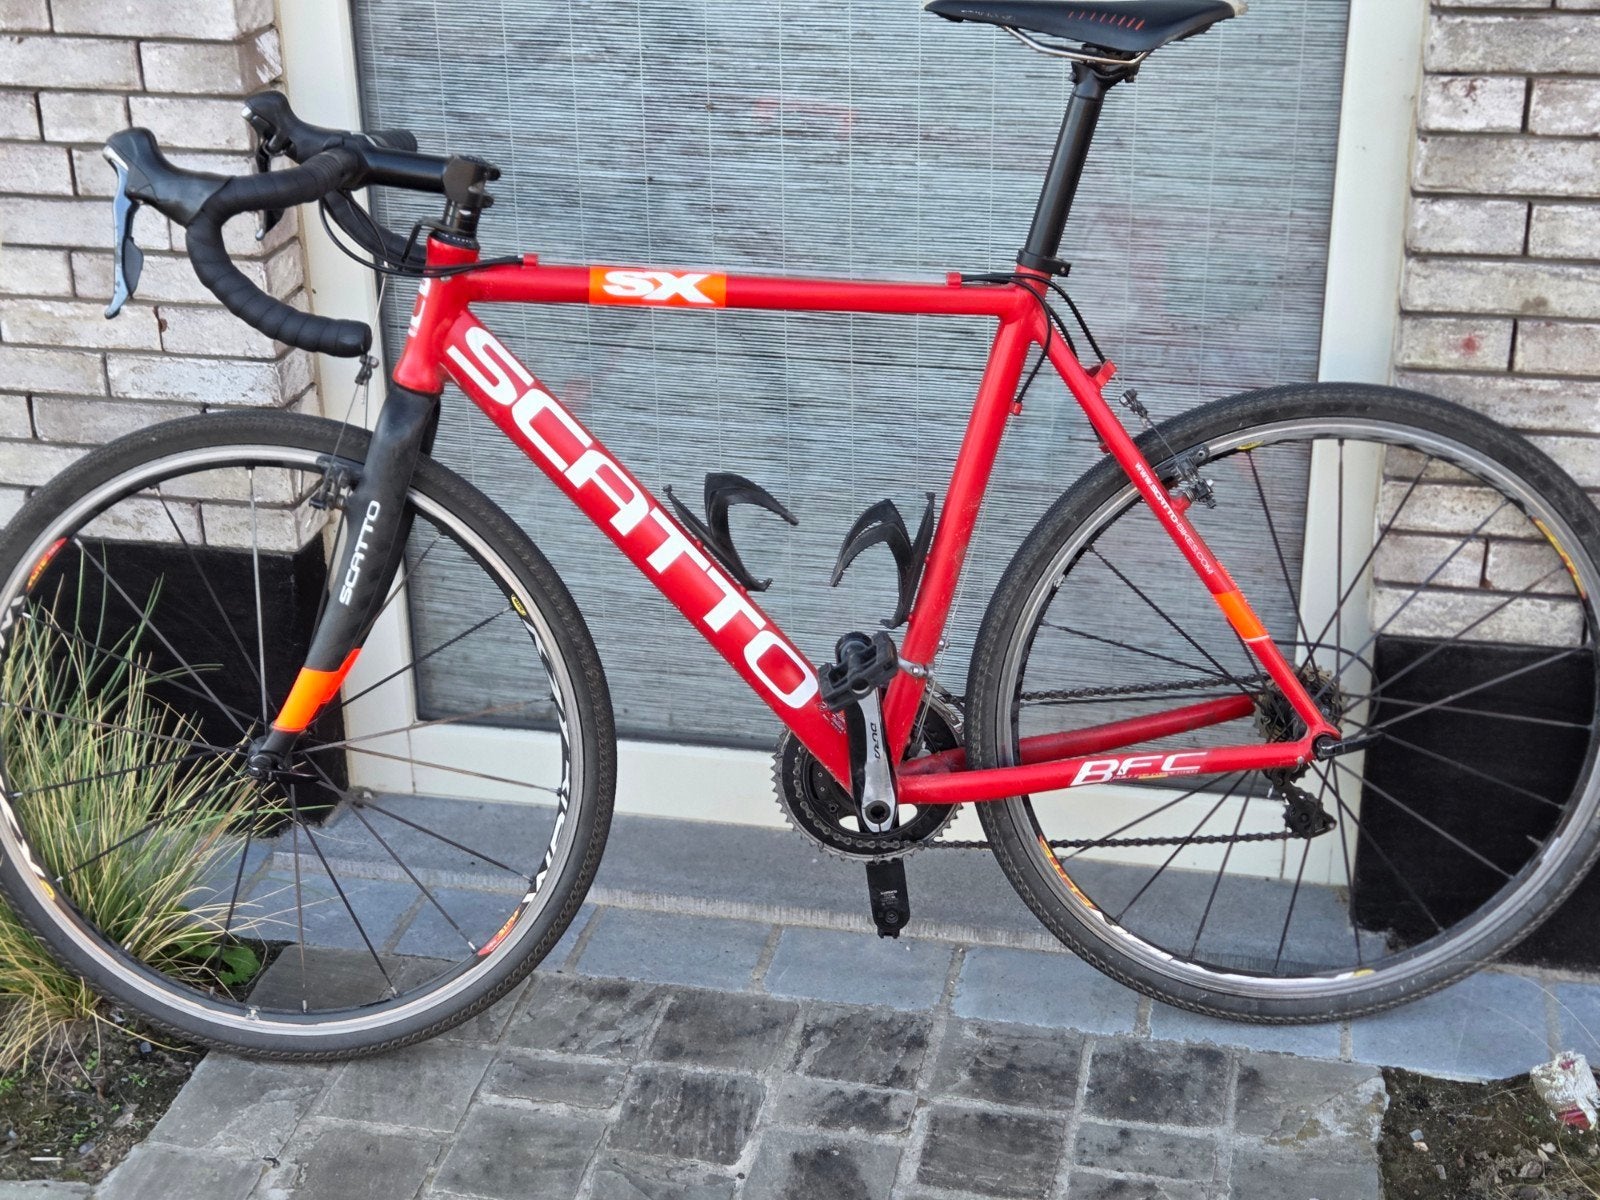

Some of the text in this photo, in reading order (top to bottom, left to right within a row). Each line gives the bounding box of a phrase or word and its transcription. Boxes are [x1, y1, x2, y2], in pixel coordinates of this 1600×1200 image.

[602, 271, 715, 304] SX
[339, 500, 380, 606] SCATTO
[446, 327, 819, 709] SCATTO
[1069, 752, 1208, 786] BFC
